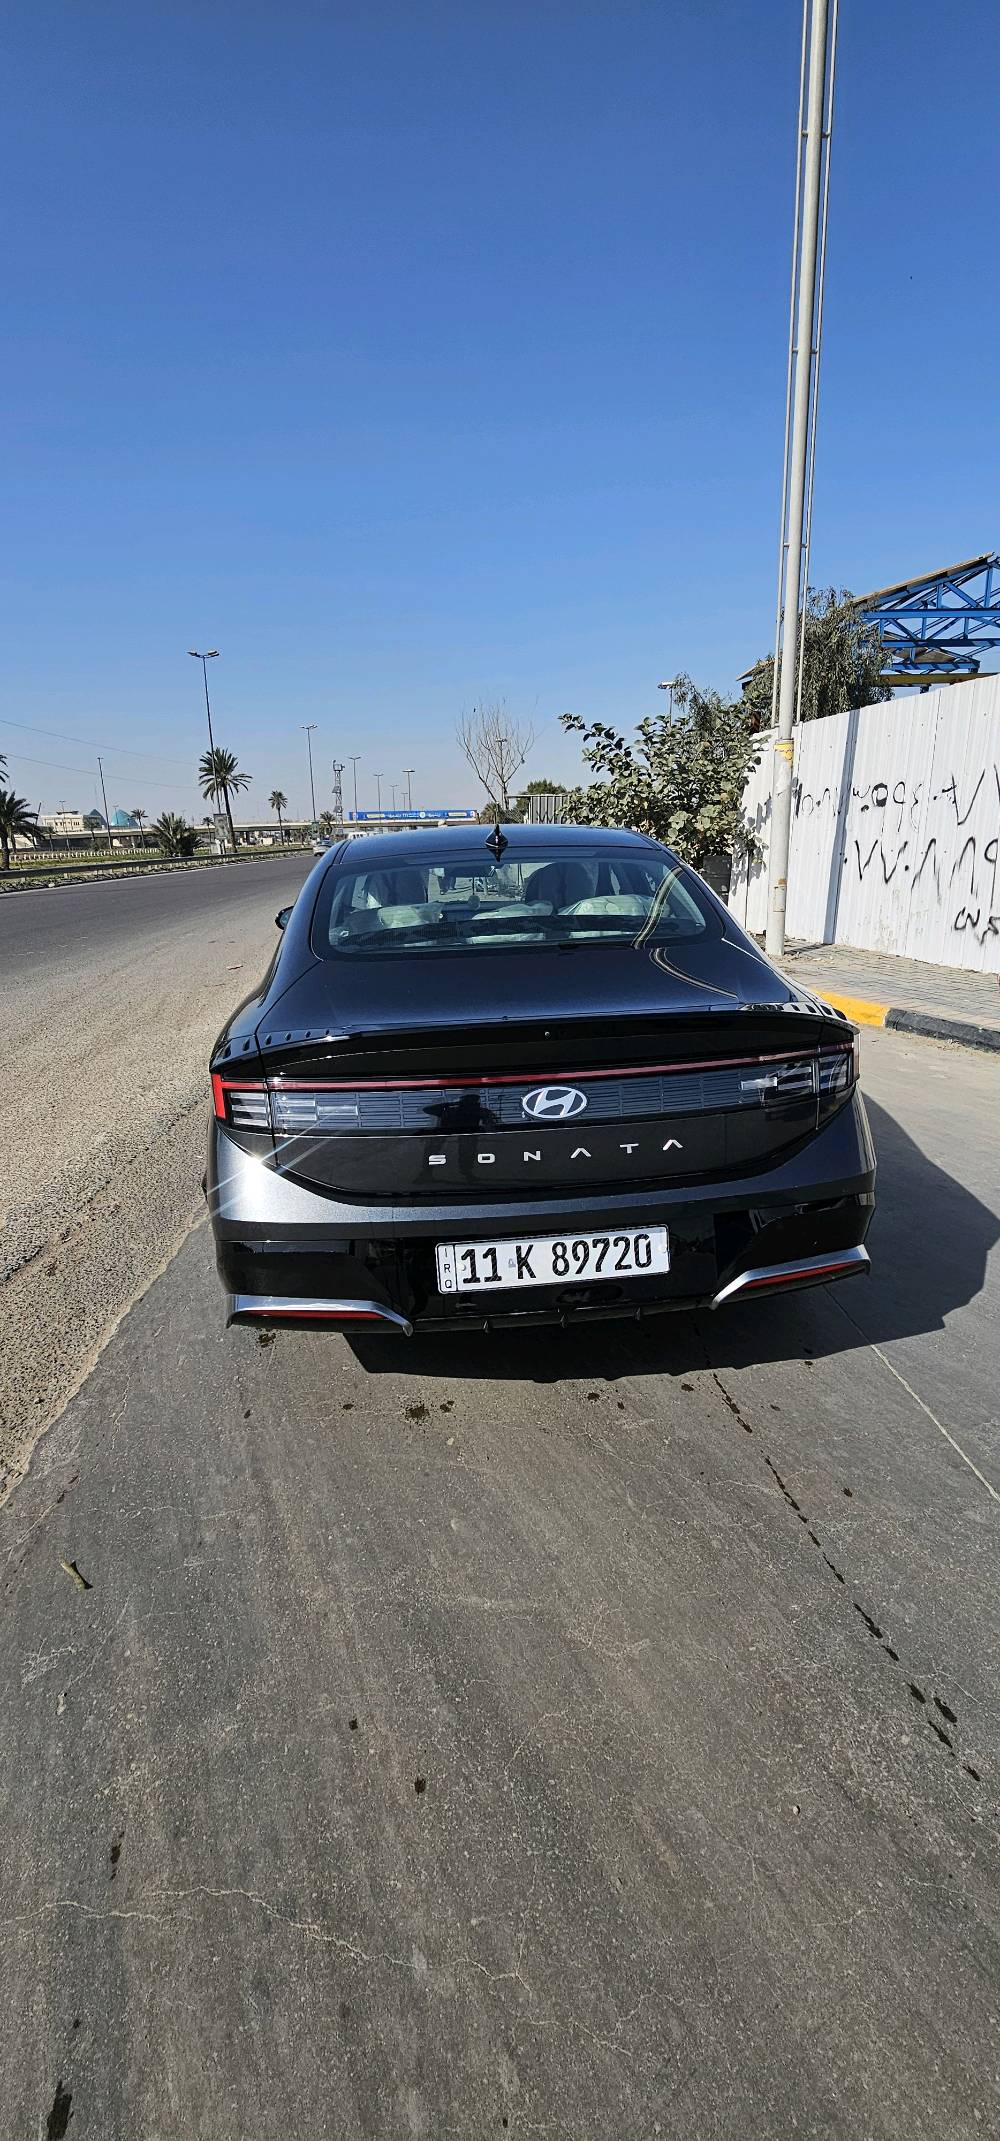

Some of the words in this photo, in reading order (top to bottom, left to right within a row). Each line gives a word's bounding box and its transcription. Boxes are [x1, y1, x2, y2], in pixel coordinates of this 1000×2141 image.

[428, 1138, 684, 1165] SONATA
[461, 1246, 502, 1284] 11
[515, 1244, 537, 1280] K
[551, 1233, 653, 1277] 89720
